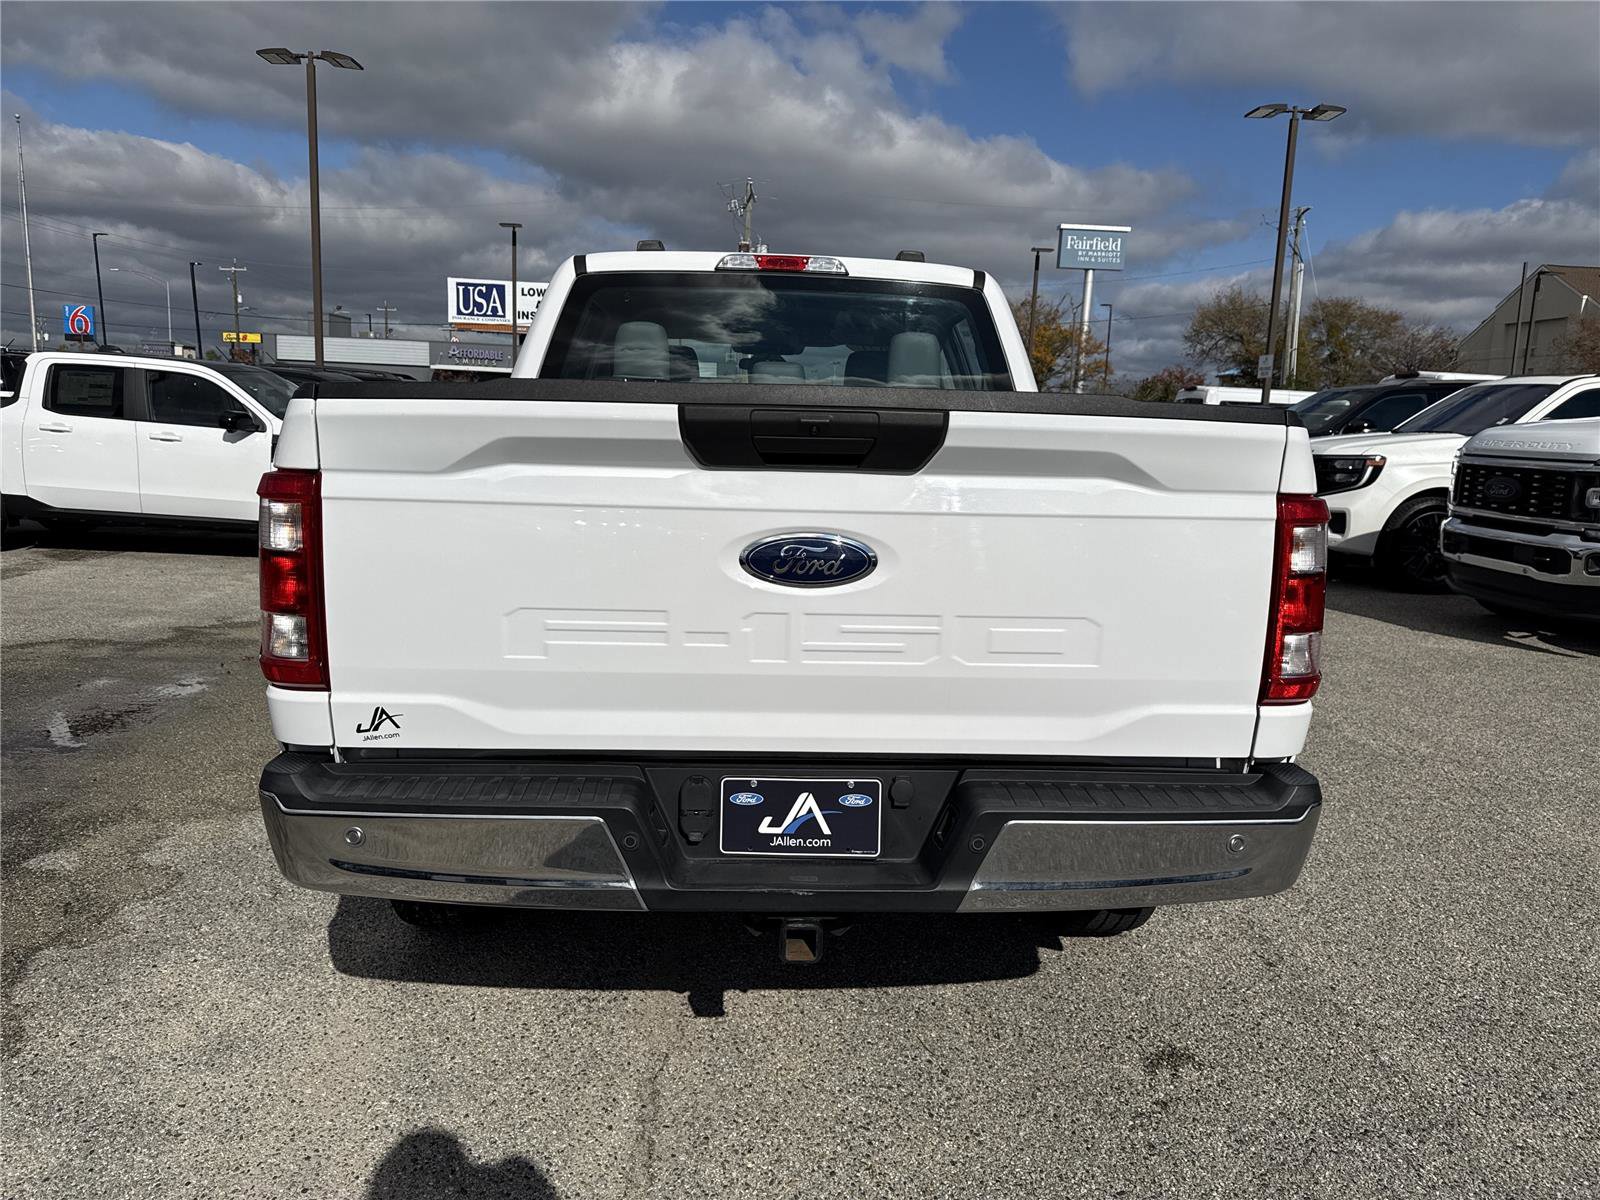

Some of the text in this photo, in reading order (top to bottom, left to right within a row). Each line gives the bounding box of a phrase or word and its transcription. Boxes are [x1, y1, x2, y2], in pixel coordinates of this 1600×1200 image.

[1066, 235, 1121, 251] Fairfield
[457, 285, 504, 316] USA
[69, 305, 91, 335] 6
[448, 345, 504, 360] AFFORDABLE
[455, 358, 497, 366] SMILES
[1475, 439, 1574, 451] SUPER DUTY
[773, 544, 845, 576] Ford
[502, 607, 1102, 668] F-150
[362, 733, 401, 741] JAllen.com
[735, 793, 758, 804] Ford
[844, 795, 867, 806] Ford
[769, 836, 832, 847] JAllen.com
